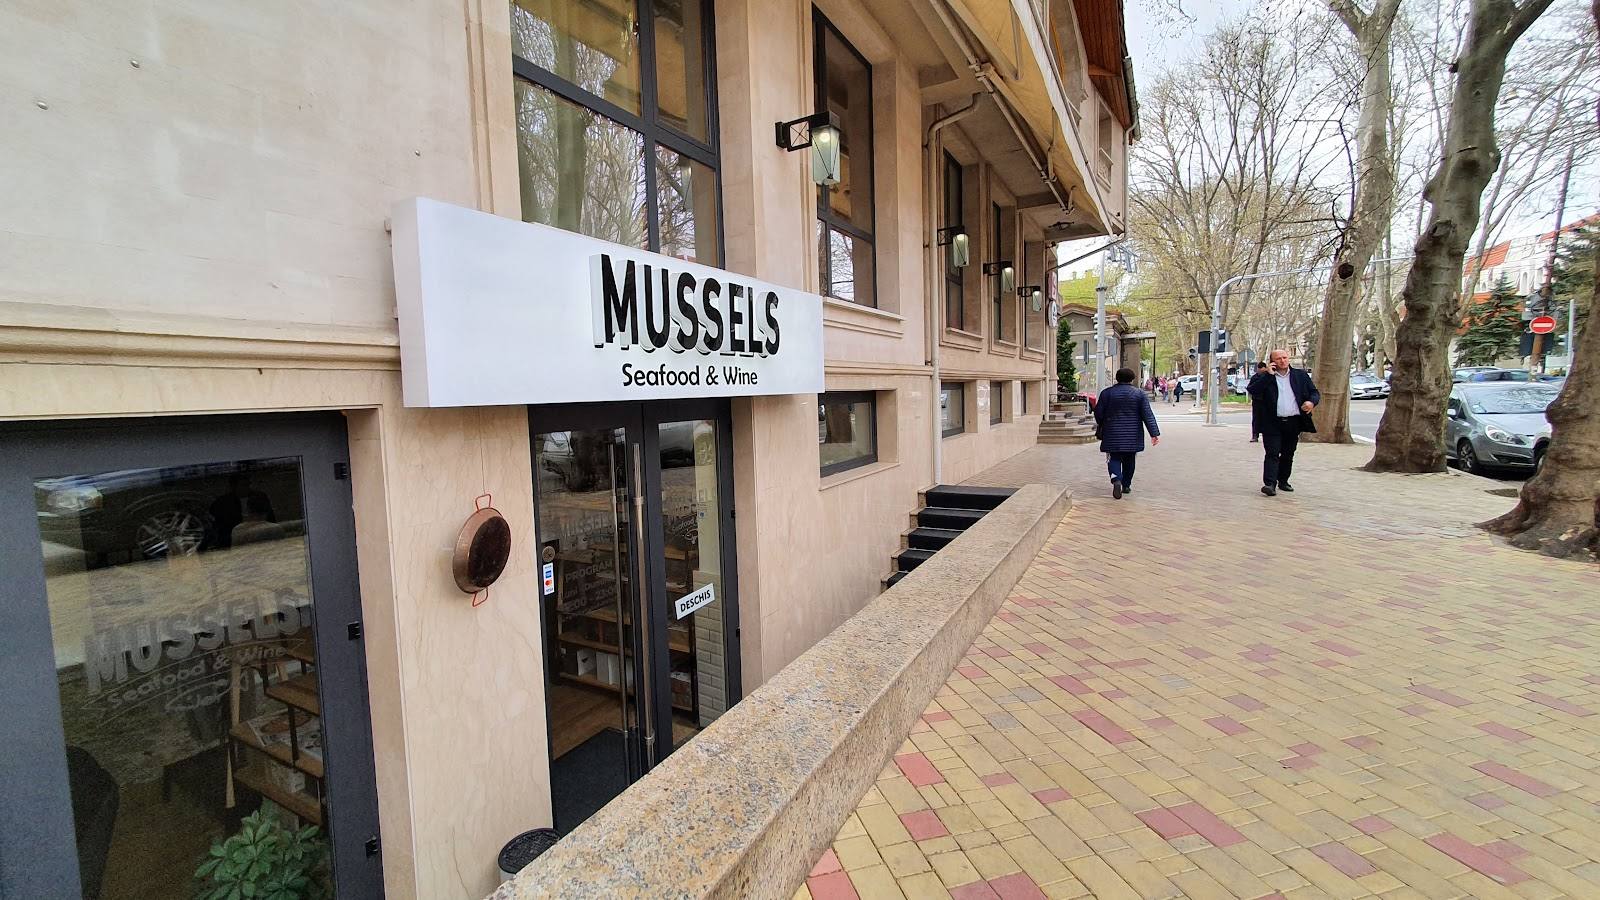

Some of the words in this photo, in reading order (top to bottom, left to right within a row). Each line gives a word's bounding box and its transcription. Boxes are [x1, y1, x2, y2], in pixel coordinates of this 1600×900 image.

[600, 253, 780, 356] MUSSELS
[621, 363, 700, 387] Seafood
[705, 365, 719, 386] &
[723, 366, 758, 386] Wine
[680, 589, 711, 612] DESCHIS
[84, 587, 302, 695] MUSSELS
[107, 658, 206, 708] Seafood
